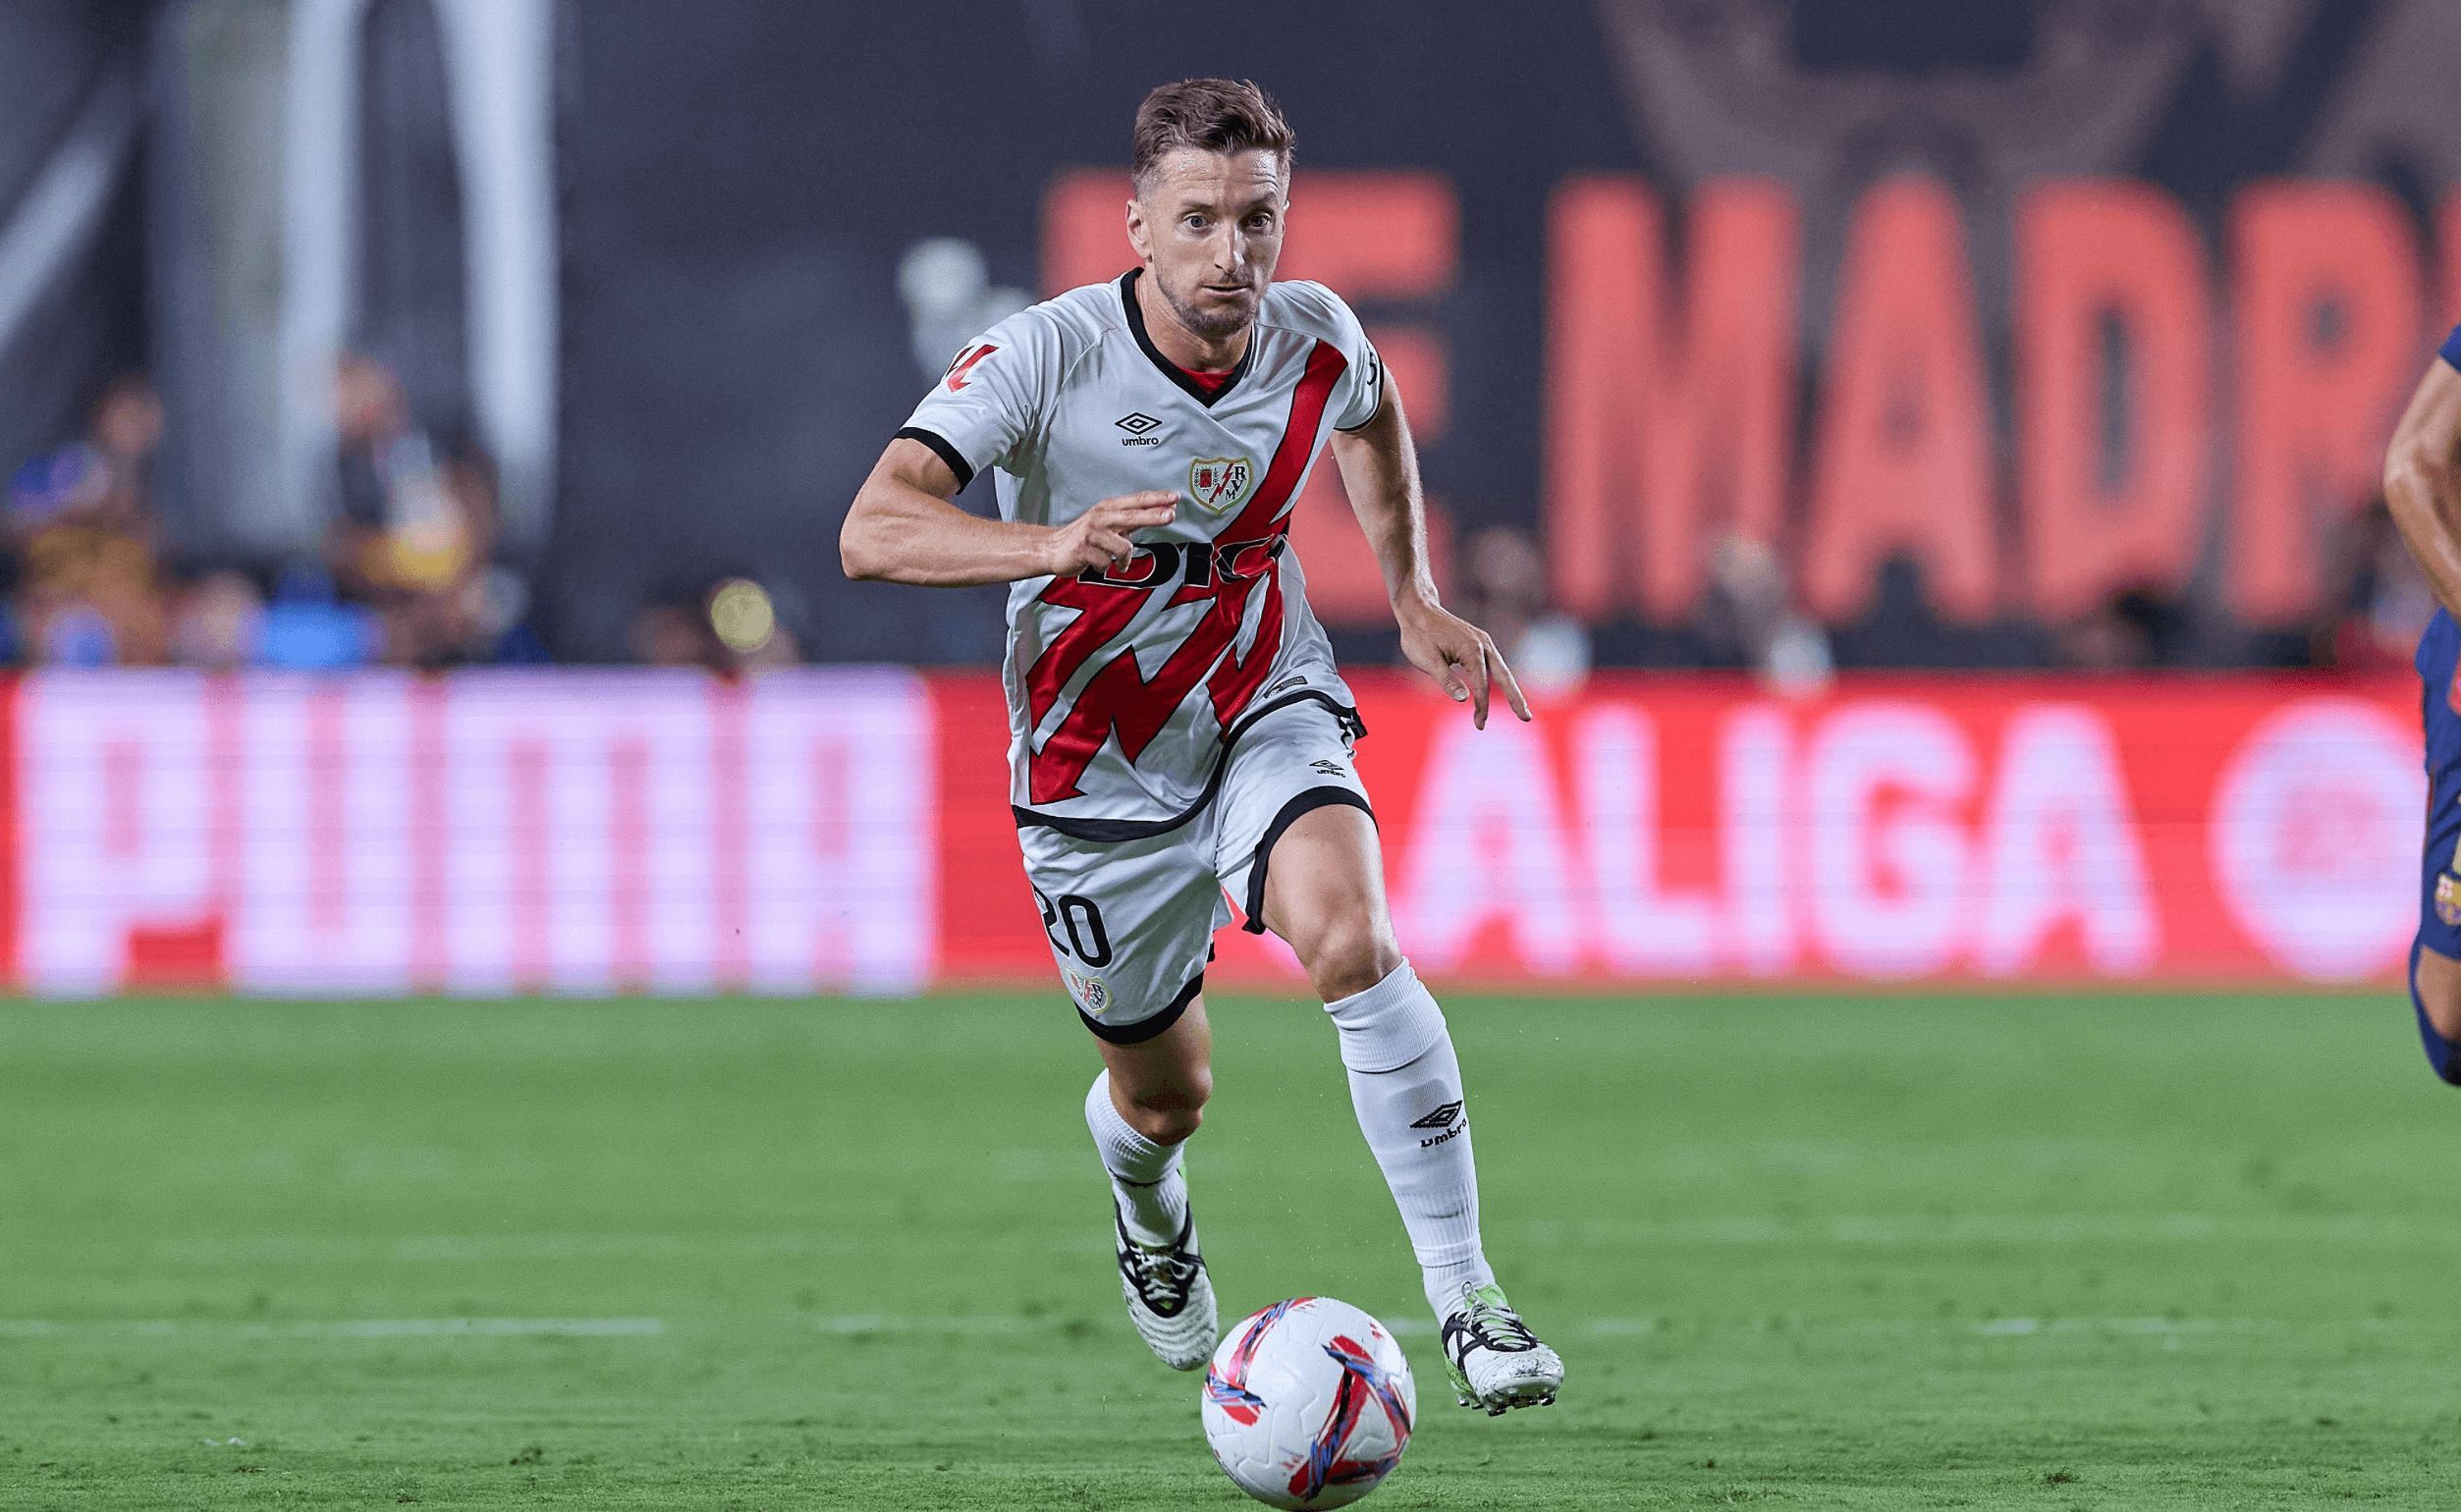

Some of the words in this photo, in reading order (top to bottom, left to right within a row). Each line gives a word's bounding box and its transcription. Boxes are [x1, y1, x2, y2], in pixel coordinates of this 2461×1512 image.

[1045, 171, 1457, 624] E
[1547, 177, 2461, 624] MADR
[1121, 436, 1159, 447] umbro
[20, 668, 933, 996] PUMA
[1031, 880, 1113, 968] 20
[1257, 697, 2156, 982] ALIGA
[1420, 1118, 1467, 1148] umbro
